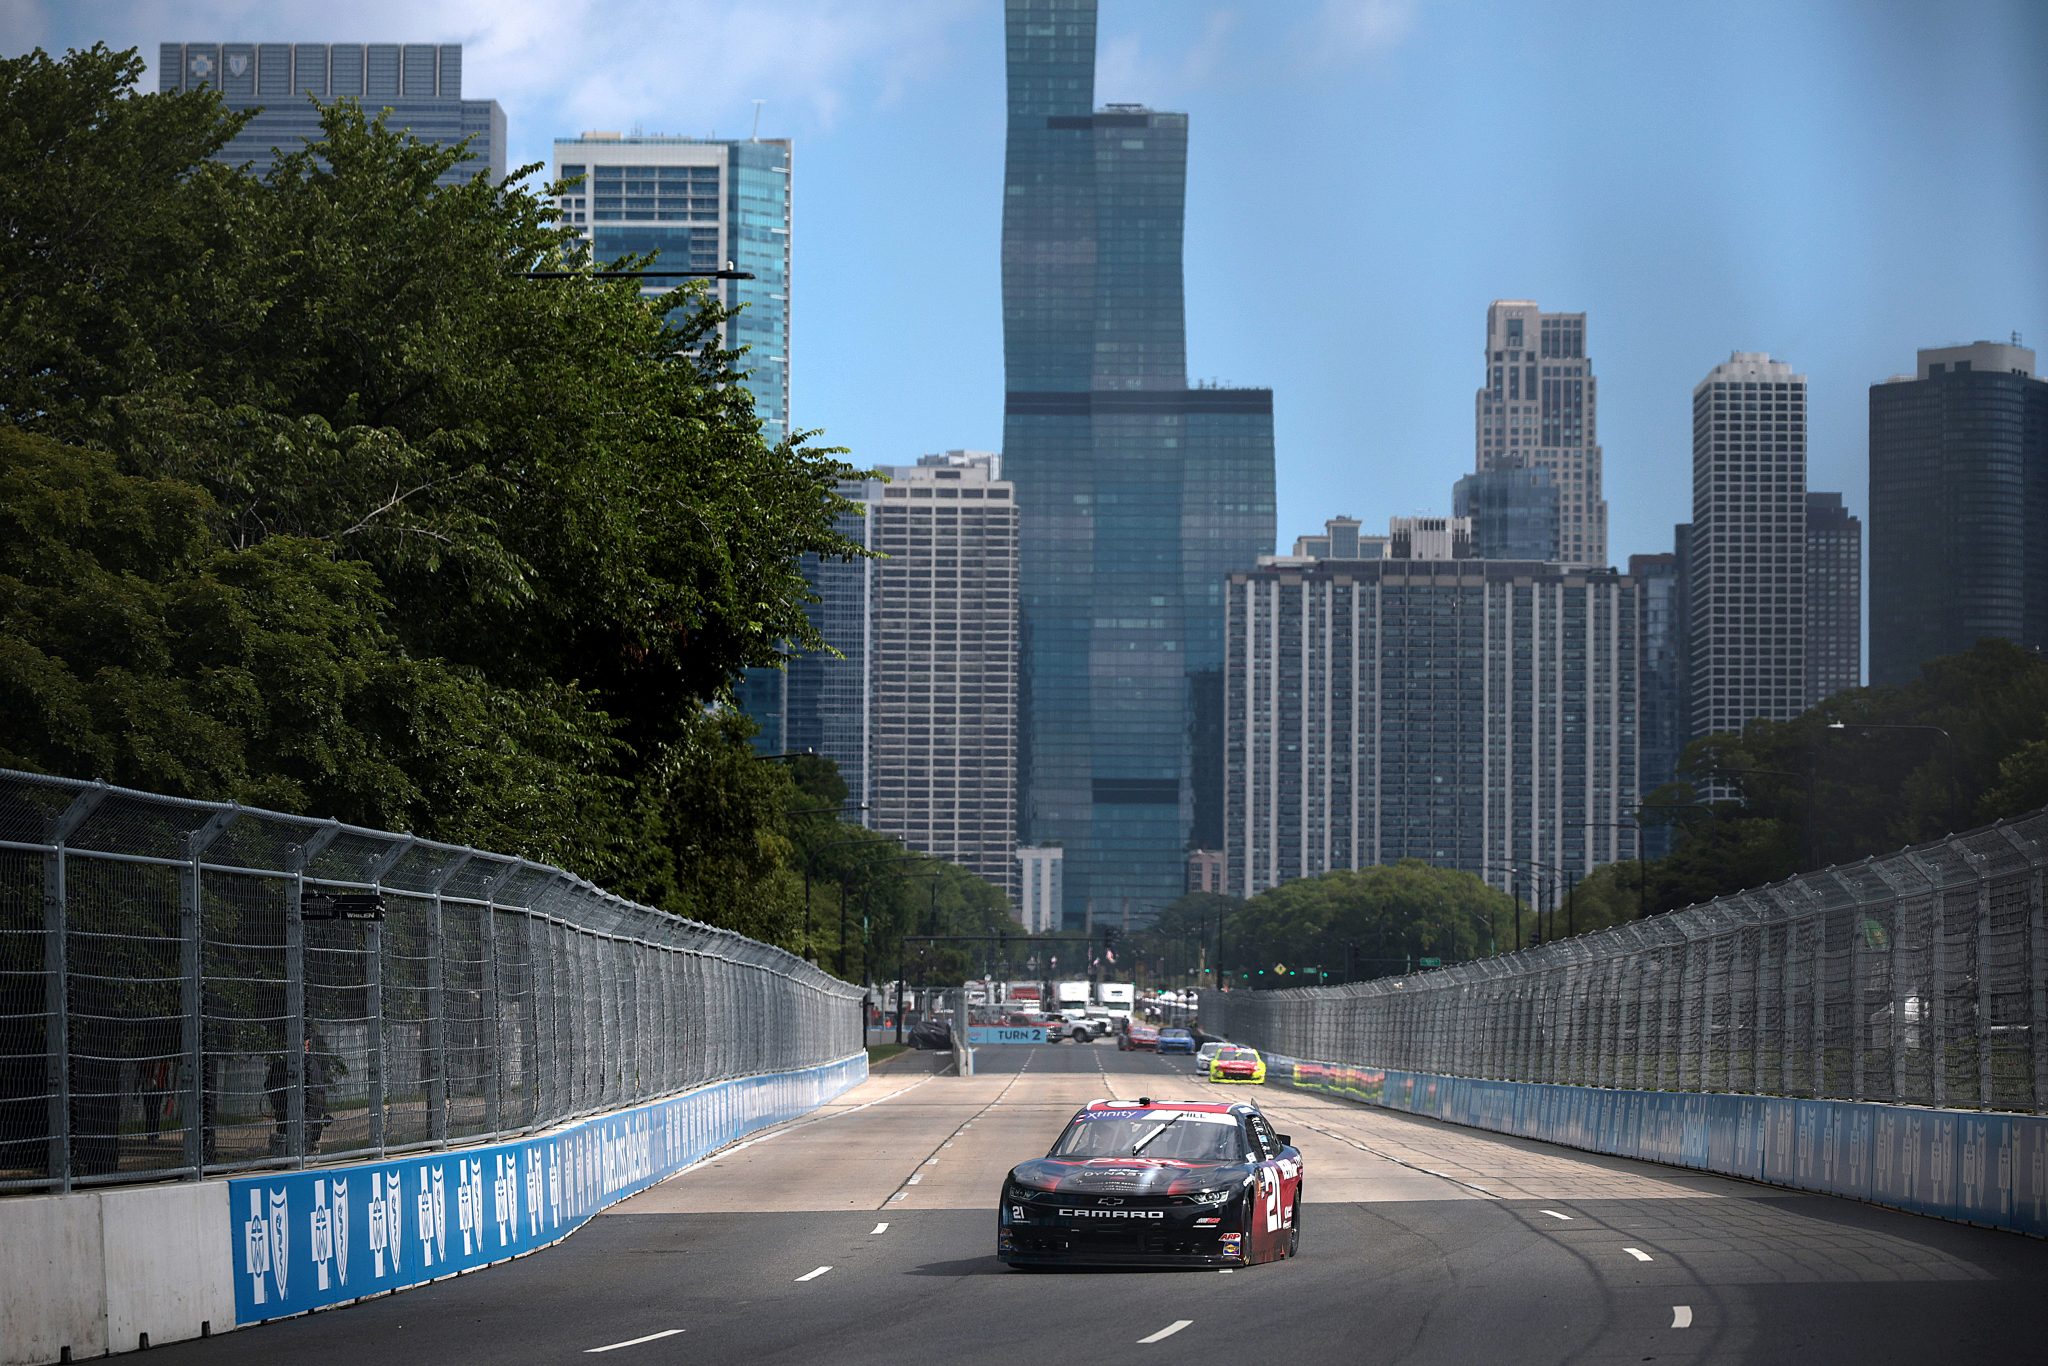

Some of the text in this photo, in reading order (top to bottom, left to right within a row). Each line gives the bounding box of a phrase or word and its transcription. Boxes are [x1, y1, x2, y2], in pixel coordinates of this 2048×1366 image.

[997, 1029, 1041, 1041] TURN 2
[1087, 1110, 1138, 1120] xfinity
[1263, 1165, 1282, 1233] 21
[1012, 1205, 1025, 1220] 21
[1058, 1208, 1164, 1219] CAMARO
